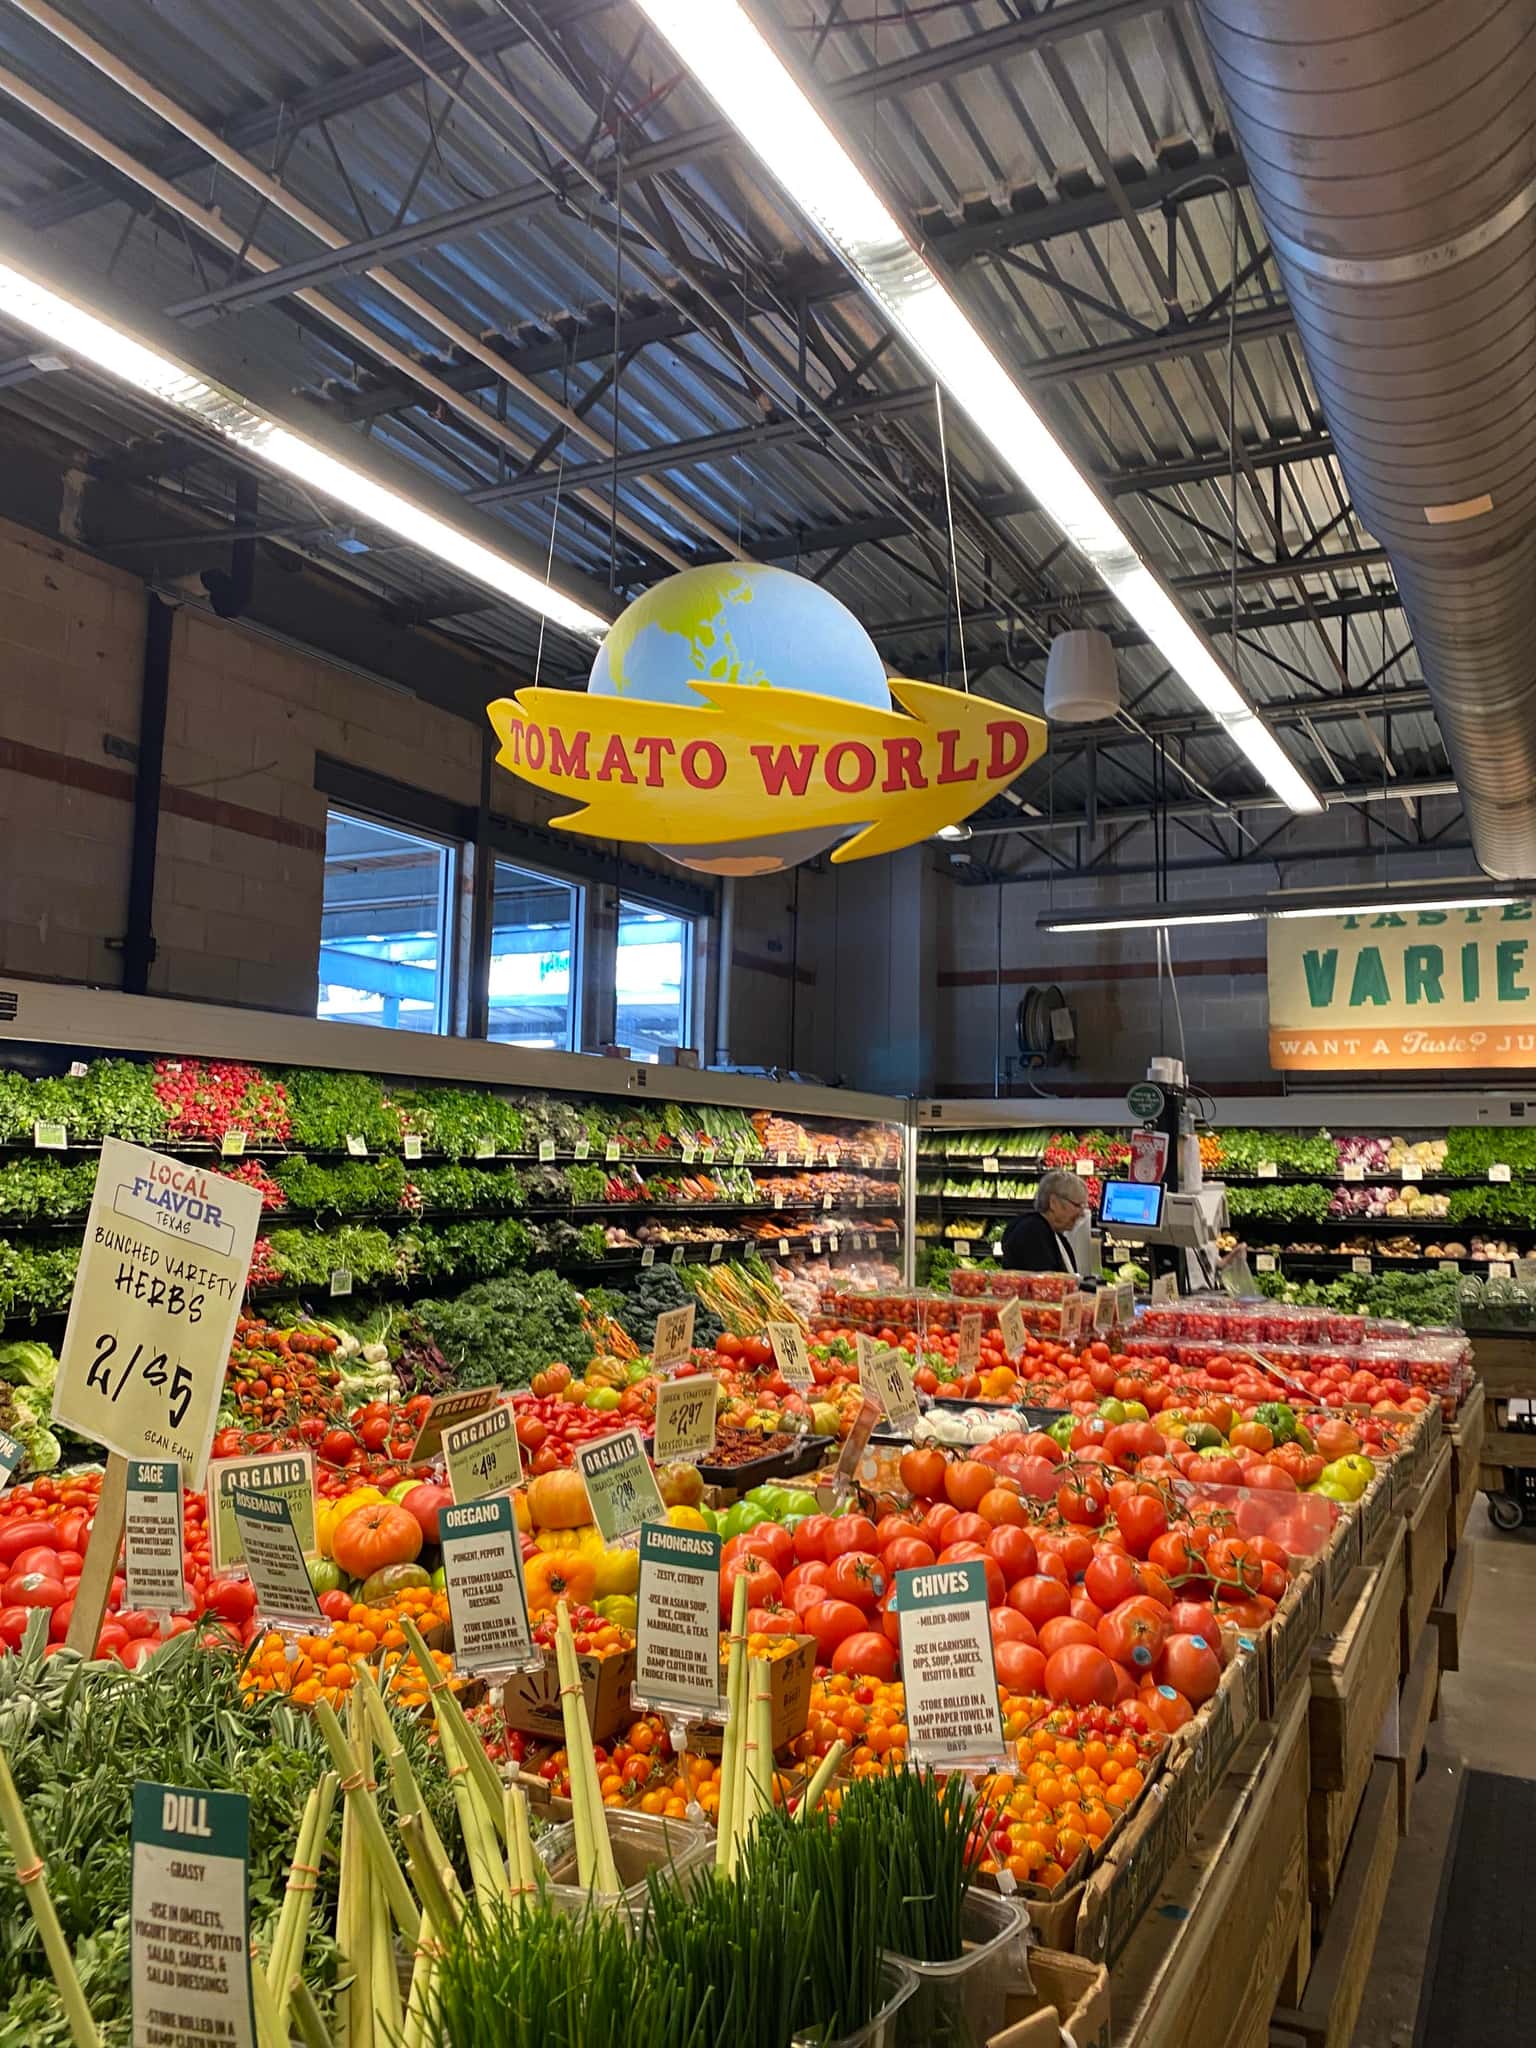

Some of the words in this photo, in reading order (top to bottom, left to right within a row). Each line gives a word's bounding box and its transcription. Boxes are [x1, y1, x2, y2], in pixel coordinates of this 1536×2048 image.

[511, 719, 727, 790] TOMATO
[750, 721, 1029, 796] WORLD
[1302, 939, 1530, 1008] VARIE
[1280, 1038, 1361, 1056] WANT
[1372, 1040, 1390, 1056] A
[1401, 1031, 1487, 1056] Taste?
[149, 1160, 209, 1200] LOCAL
[132, 1177, 222, 1228] FLAVOR
[156, 1211, 191, 1235] TEXAS
[95, 1226, 160, 1267] BUNCHED
[166, 1256, 237, 1301] VARIETY
[115, 1263, 204, 1323] HERBS
[435, 1393, 487, 1417] ORGANIC
[452, 1414, 506, 1450] ORGANIC
[144, 1430, 169, 1453] SCAN
[172, 1441, 194, 1463] EACH
[585, 1438, 635, 1475] ORGANIC
[138, 1464, 164, 1484] SAGE
[228, 1463, 300, 1491] ORGANIC
[236, 1492, 283, 1515] ROSEMARY
[446, 1503, 500, 1529] OREGANO
[647, 1531, 714, 1556] LEMONGRASS
[485, 1583, 504, 1594] SALAD
[912, 1570, 969, 1599] CHIVES
[662, 1596, 669, 1605] IN
[669, 1596, 689, 1609] ASIAN
[482, 1619, 504, 1631] ROLLED
[692, 1626, 708, 1638] TEAS
[670, 1646, 693, 1660] ROLLED
[694, 1650, 701, 1660] IN
[702, 1651, 707, 1662] A
[930, 1642, 938, 1653] IN
[938, 1638, 979, 1652] GARNISHES,
[646, 1656, 666, 1669] DAMP
[666, 1659, 686, 1672] CLOTH
[688, 1662, 694, 1673] IN
[695, 1663, 707, 1676] THE
[954, 1652, 983, 1665] SAUCES,
[642, 1667, 664, 1680] FRIDGE
[665, 1671, 678, 1683] FOR
[696, 1676, 713, 1688] DAYS
[922, 1669, 952, 1682] RISOTTO
[959, 1666, 974, 1678] RICE
[944, 1696, 970, 1710] ROLLED
[971, 1695, 979, 1706] IN
[979, 1694, 986, 1705] A
[913, 1713, 934, 1726] DAMP
[935, 1711, 959, 1724] PAPER
[960, 1708, 984, 1722] TOWEL
[986, 1707, 994, 1719] IN
[918, 1727, 931, 1740] THE
[931, 1724, 958, 1740] FRIDGE
[959, 1723, 974, 1735] FOR
[974, 1721, 993, 1735] 10-14
[947, 1739, 967, 1753] DAYS
[162, 1792, 212, 1838] DILL
[169, 1904, 178, 1921] IN
[180, 1906, 224, 1930] OMELETS,
[204, 1932, 242, 1952] POTATO
[146, 1966, 175, 1986] SALAD
[176, 1970, 229, 1994] DRESSINGS
